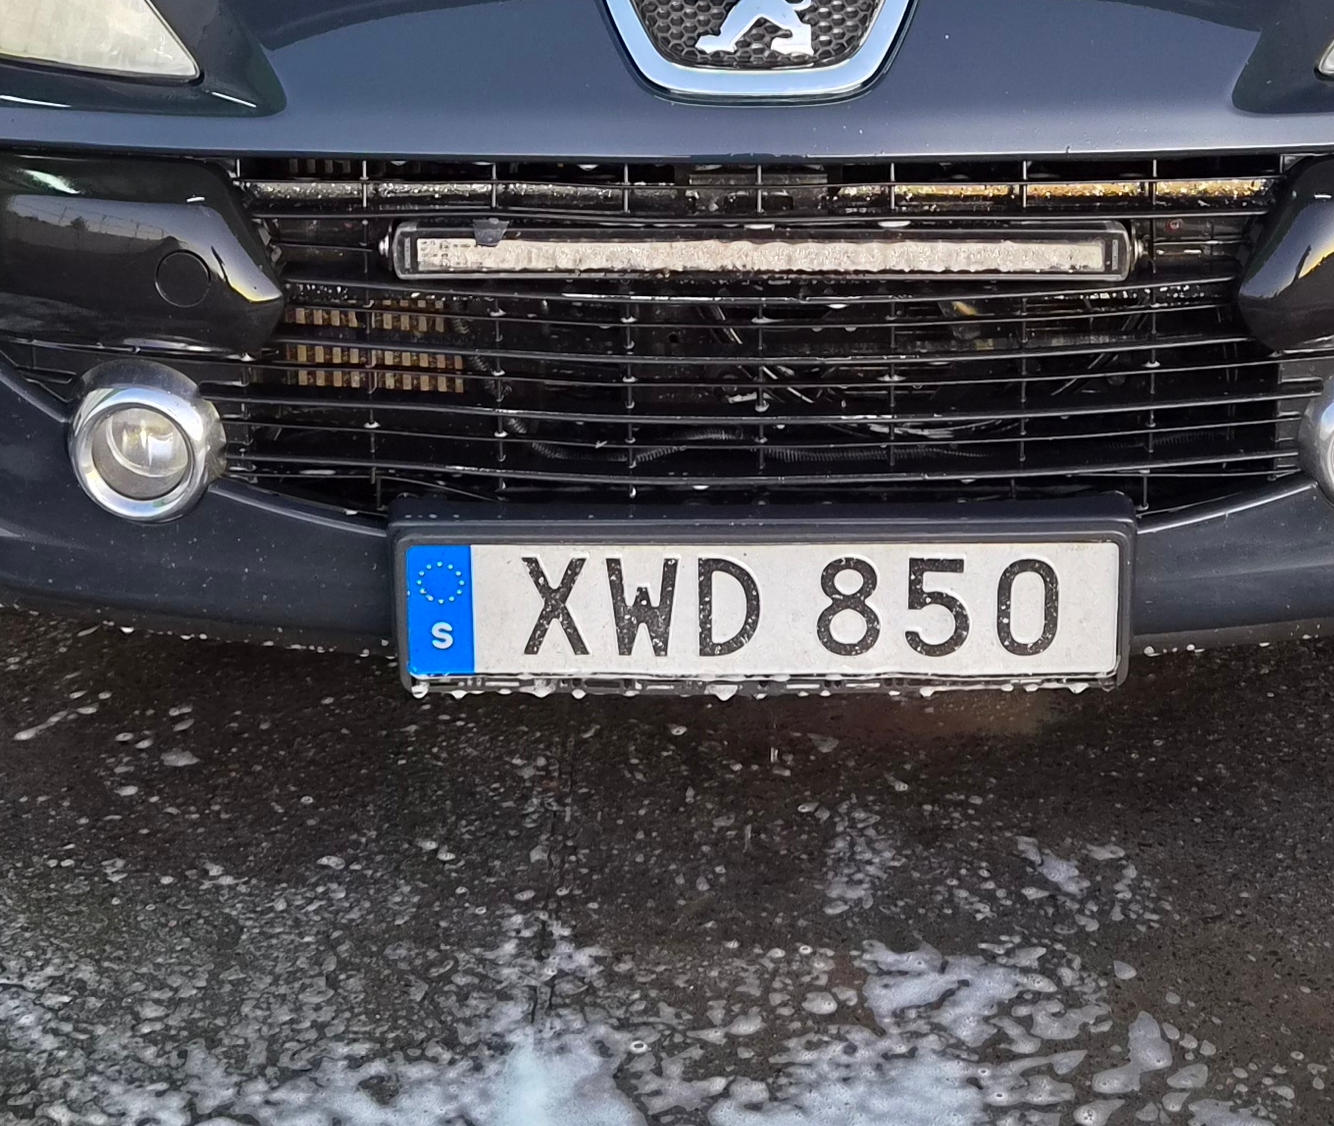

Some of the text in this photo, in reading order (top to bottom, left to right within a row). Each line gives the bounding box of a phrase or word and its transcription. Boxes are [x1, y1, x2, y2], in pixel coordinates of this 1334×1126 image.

[431, 622, 454, 650] S
[521, 556, 1060, 657] XWD 850
